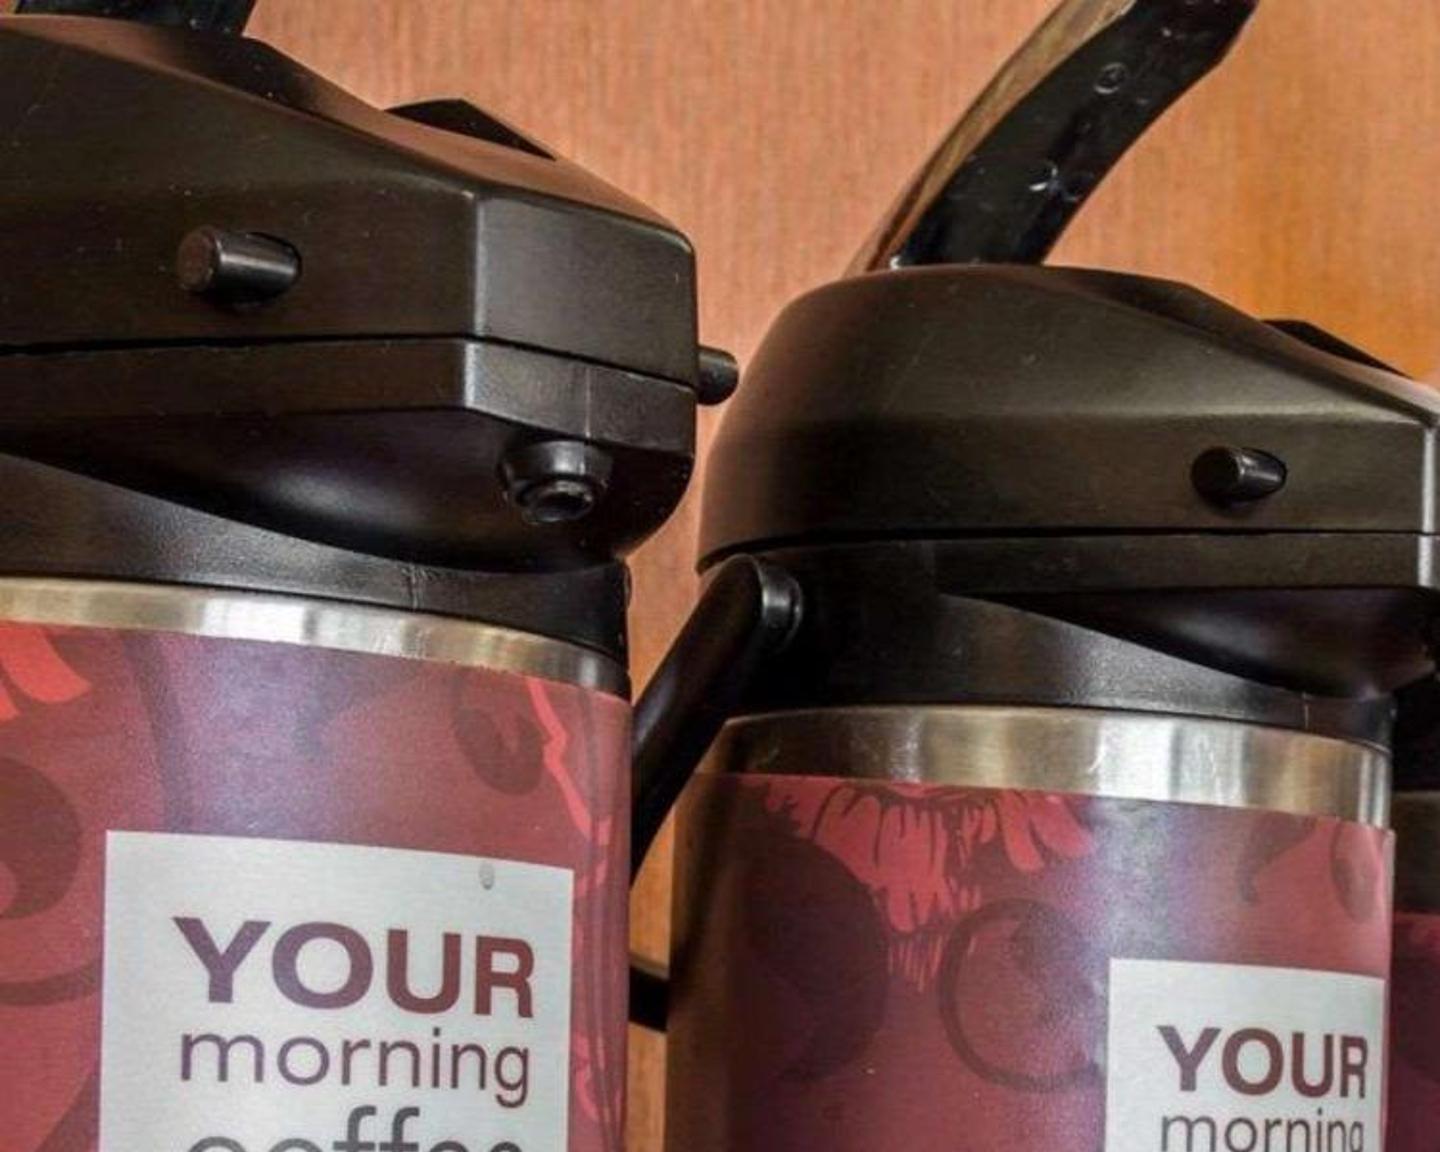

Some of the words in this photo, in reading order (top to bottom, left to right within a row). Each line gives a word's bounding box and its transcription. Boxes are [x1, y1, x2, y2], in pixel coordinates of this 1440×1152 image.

[173, 916, 535, 1018] YOUR
[180, 1027, 530, 1109] morning
[1156, 1024, 1369, 1099] YOUR
